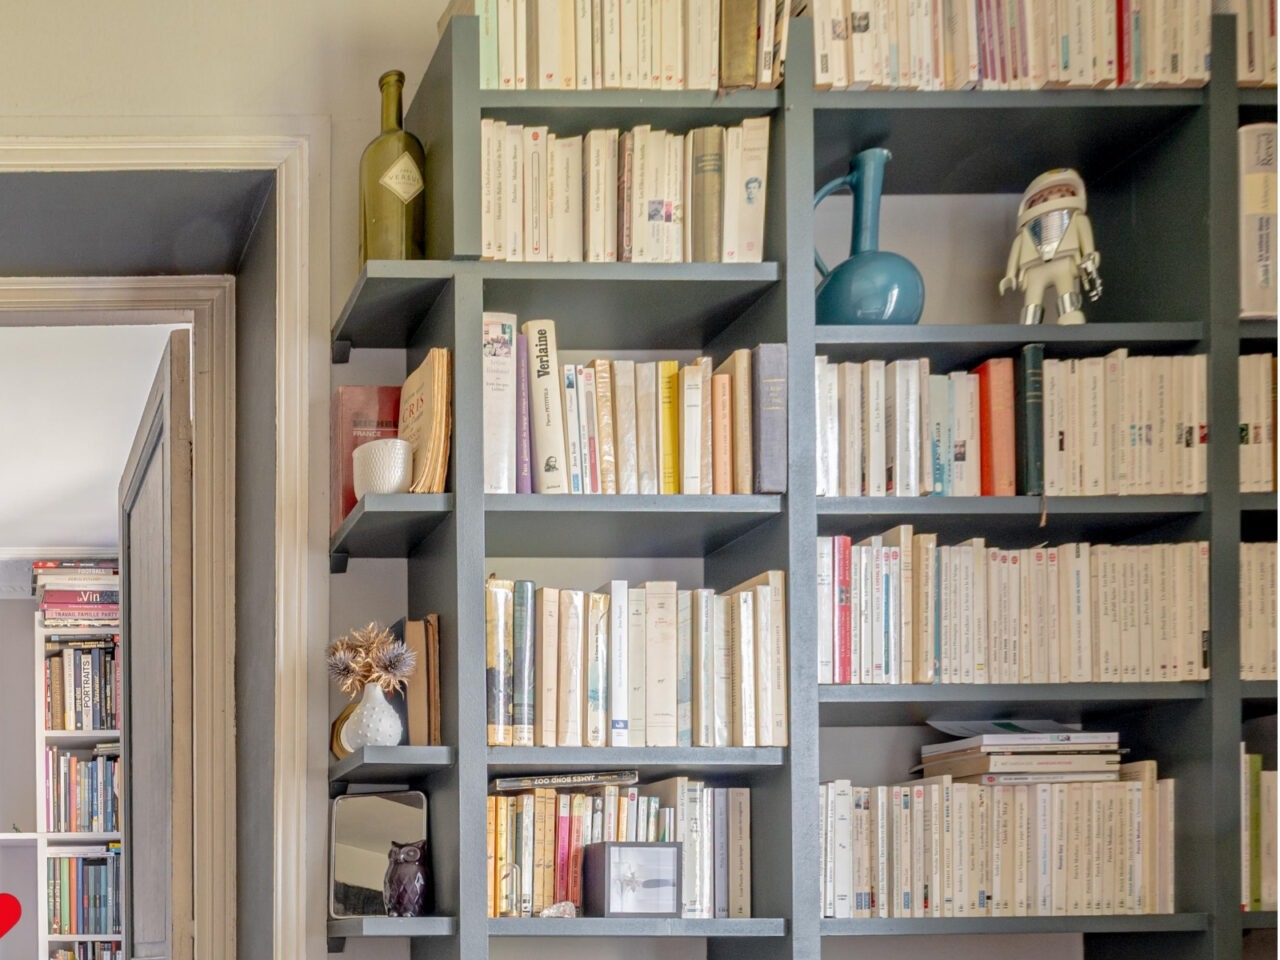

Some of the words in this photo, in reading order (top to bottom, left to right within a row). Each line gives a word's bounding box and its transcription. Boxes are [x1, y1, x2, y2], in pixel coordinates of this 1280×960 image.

[535, 328, 551, 379] Verlaine
[352, 430, 382, 438] FRANCE
[81, 591, 100, 602] Vin
[83, 660, 91, 709] PORTRAITS
